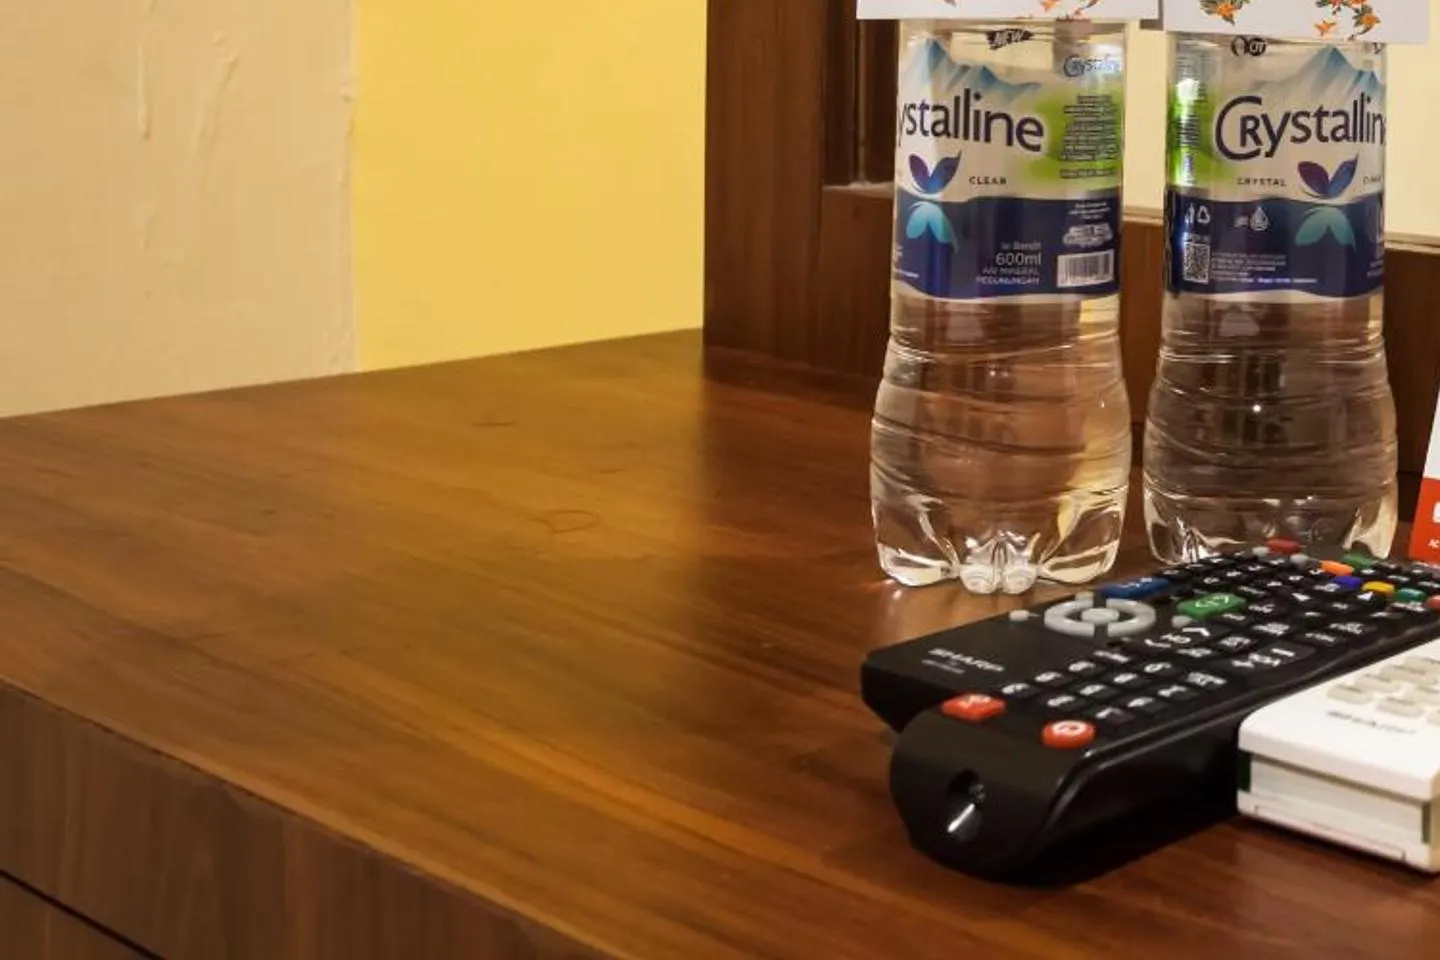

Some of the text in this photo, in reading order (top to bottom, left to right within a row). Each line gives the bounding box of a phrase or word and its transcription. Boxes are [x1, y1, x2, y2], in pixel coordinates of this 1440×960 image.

[1236, 177, 1287, 187] CRYSTAL
[995, 251, 1042, 266] 600ml
[1428, 538, 1440, 549] AC
